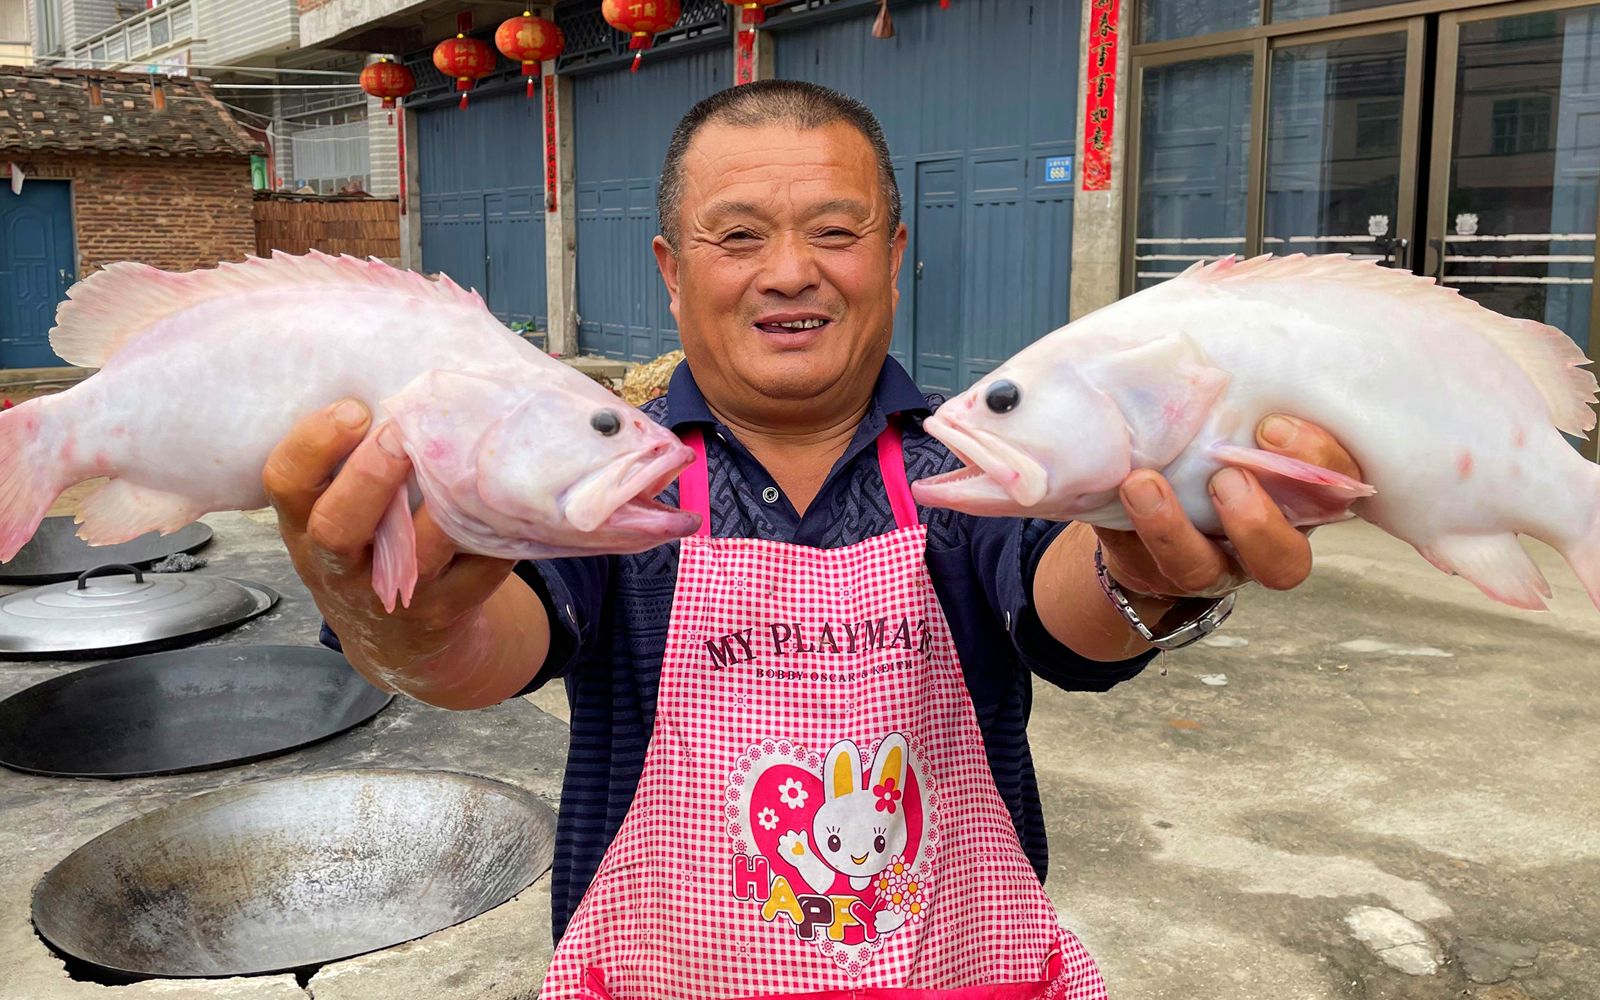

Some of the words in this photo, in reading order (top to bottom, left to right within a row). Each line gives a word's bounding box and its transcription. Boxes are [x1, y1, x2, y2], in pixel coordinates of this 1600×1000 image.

[704, 628, 757, 671] MY
[756, 668, 803, 681] BOBBY
[810, 672, 856, 682] OSCAR
[872, 660, 913, 675] KEITH
[732, 853, 888, 942] HAPPY
